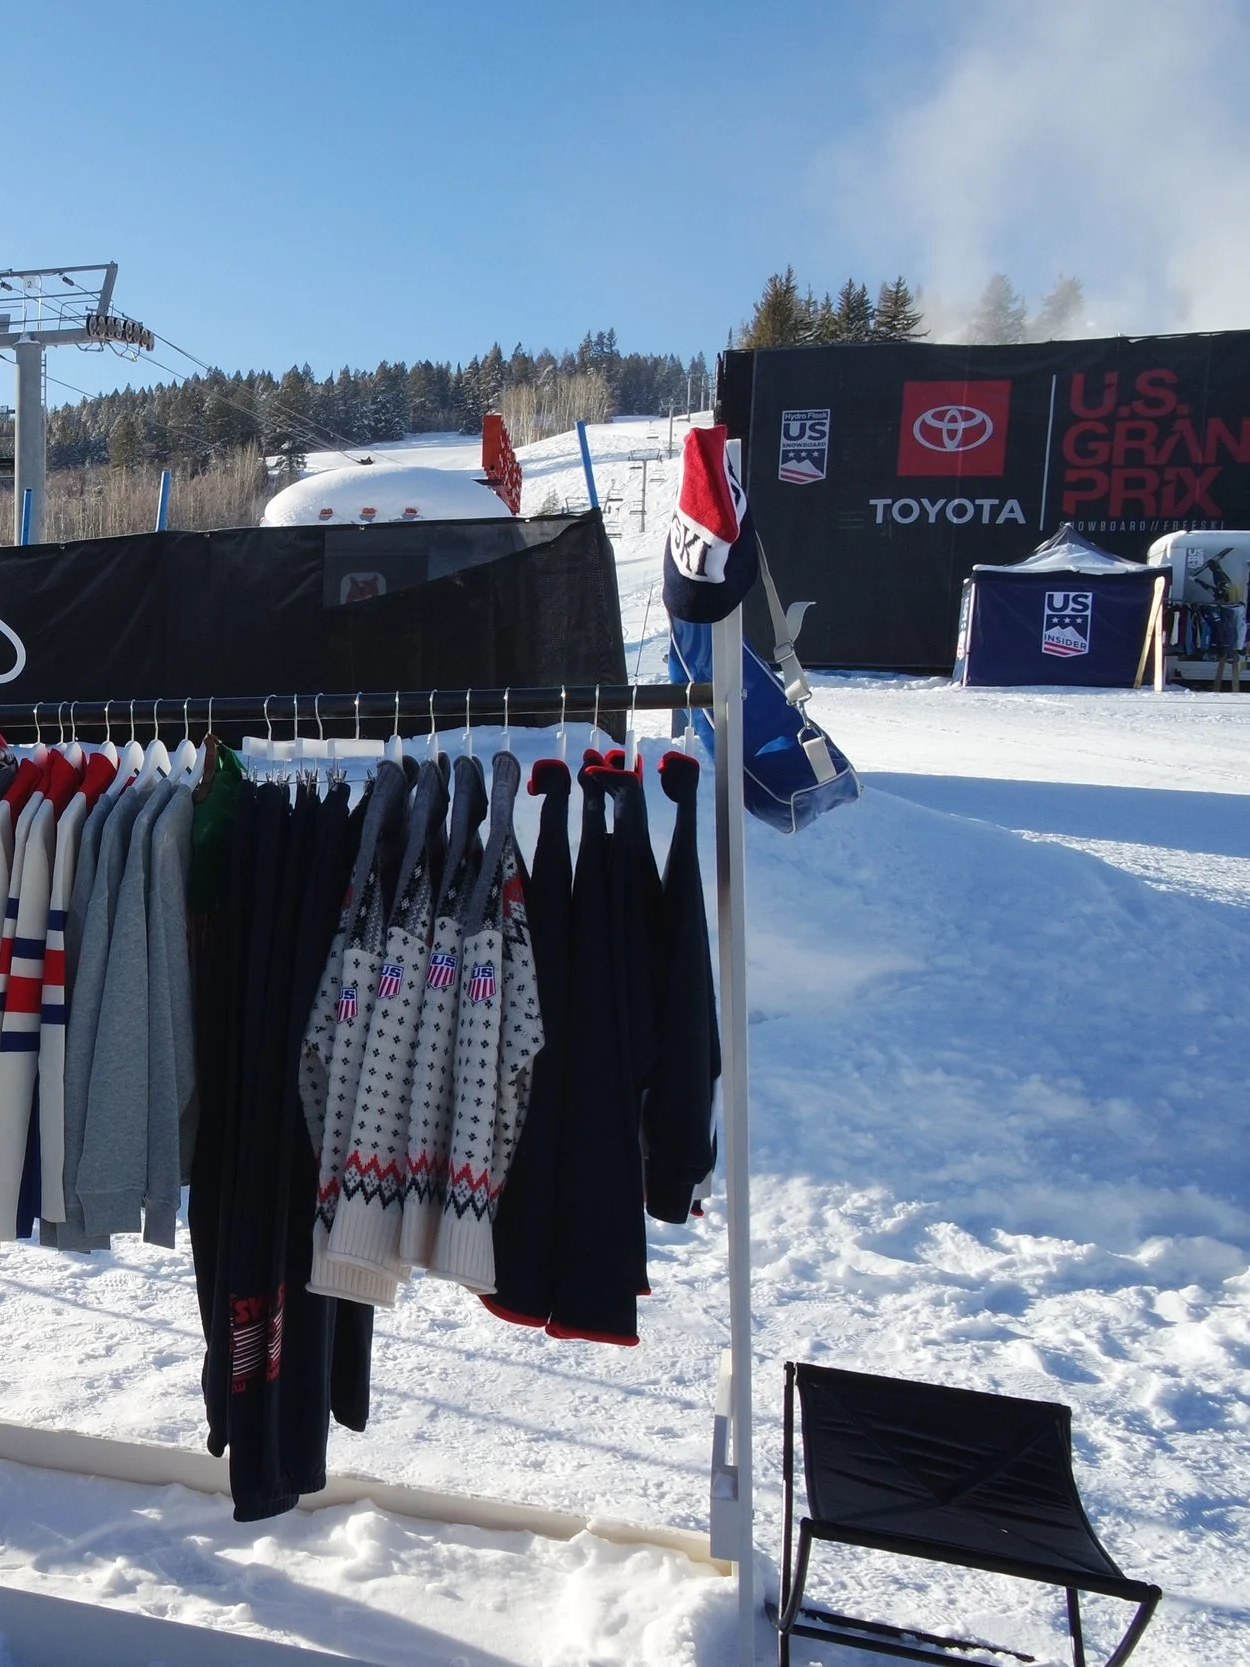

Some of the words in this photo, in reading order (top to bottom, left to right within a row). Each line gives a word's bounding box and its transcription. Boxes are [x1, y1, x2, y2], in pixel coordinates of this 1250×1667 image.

[1070, 368, 1190, 419] U.S.
[784, 413, 807, 421] Hydro
[807, 411, 827, 420] Flask
[783, 421, 827, 441] US
[1062, 466, 1224, 518] PRIX
[869, 498, 1027, 524] TOYOTA
[1046, 593, 1090, 613] US
[1044, 634, 1087, 651] INSIDER
[431, 955, 456, 968] US
[471, 967, 493, 979] US
